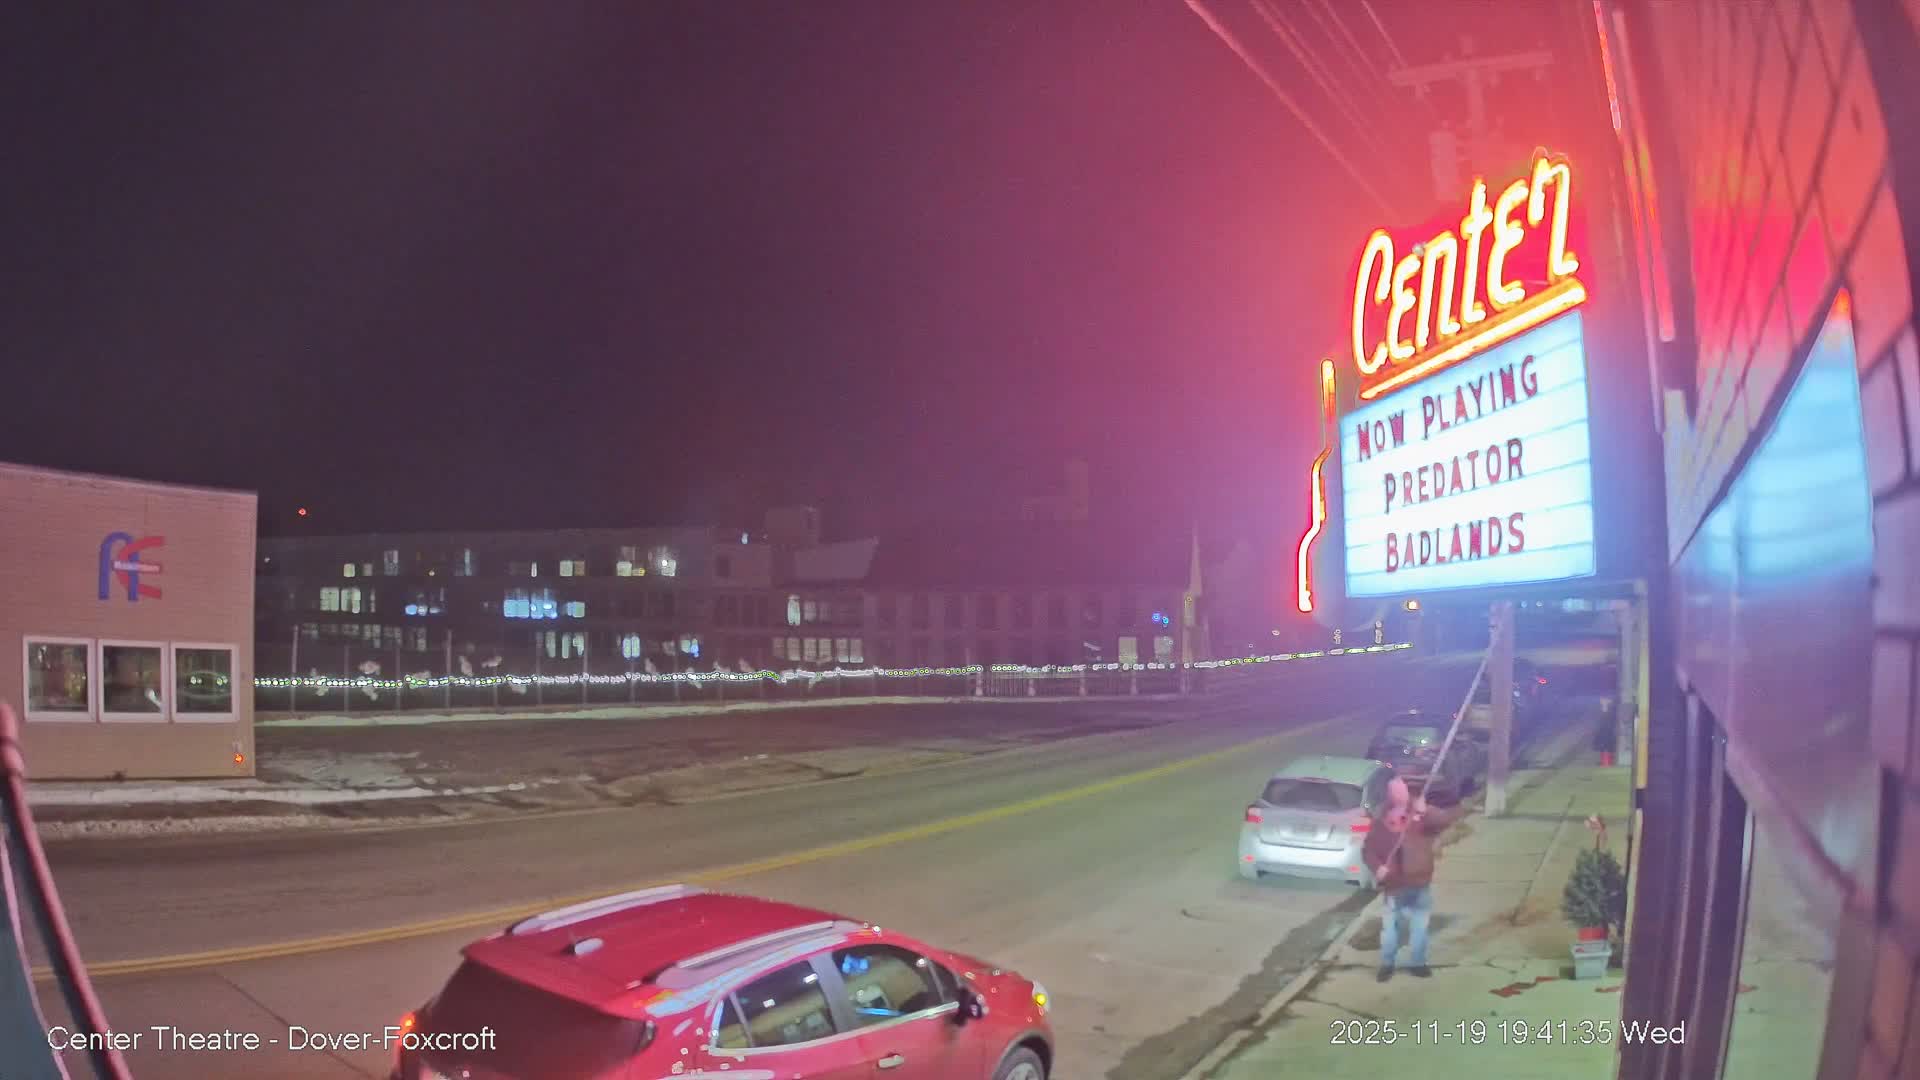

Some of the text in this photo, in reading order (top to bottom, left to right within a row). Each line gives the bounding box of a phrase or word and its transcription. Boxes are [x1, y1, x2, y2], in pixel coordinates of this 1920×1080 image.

[1352, 150, 1579, 375] Center
[1357, 355, 1538, 462] NOW PLAYING
[1384, 437, 1524, 514] PREDATOR
[1385, 512, 1525, 573] BADLANDS
